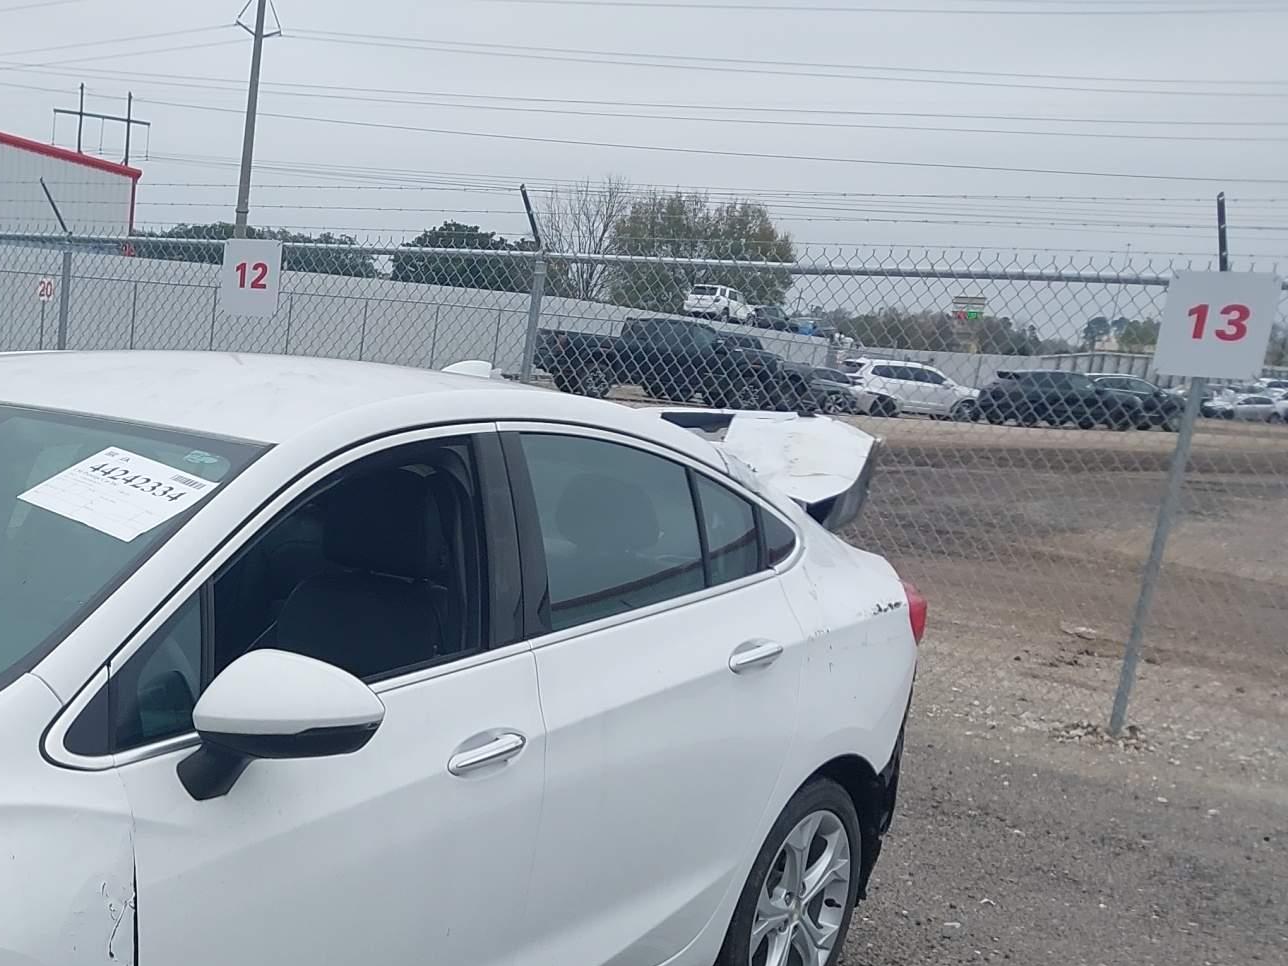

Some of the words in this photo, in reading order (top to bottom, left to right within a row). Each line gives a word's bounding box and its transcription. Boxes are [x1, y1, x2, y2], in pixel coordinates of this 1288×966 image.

[39, 280, 53, 298] 20
[235, 262, 268, 290] 12
[1187, 303, 1251, 342] 13
[89, 463, 188, 502] 44242334
